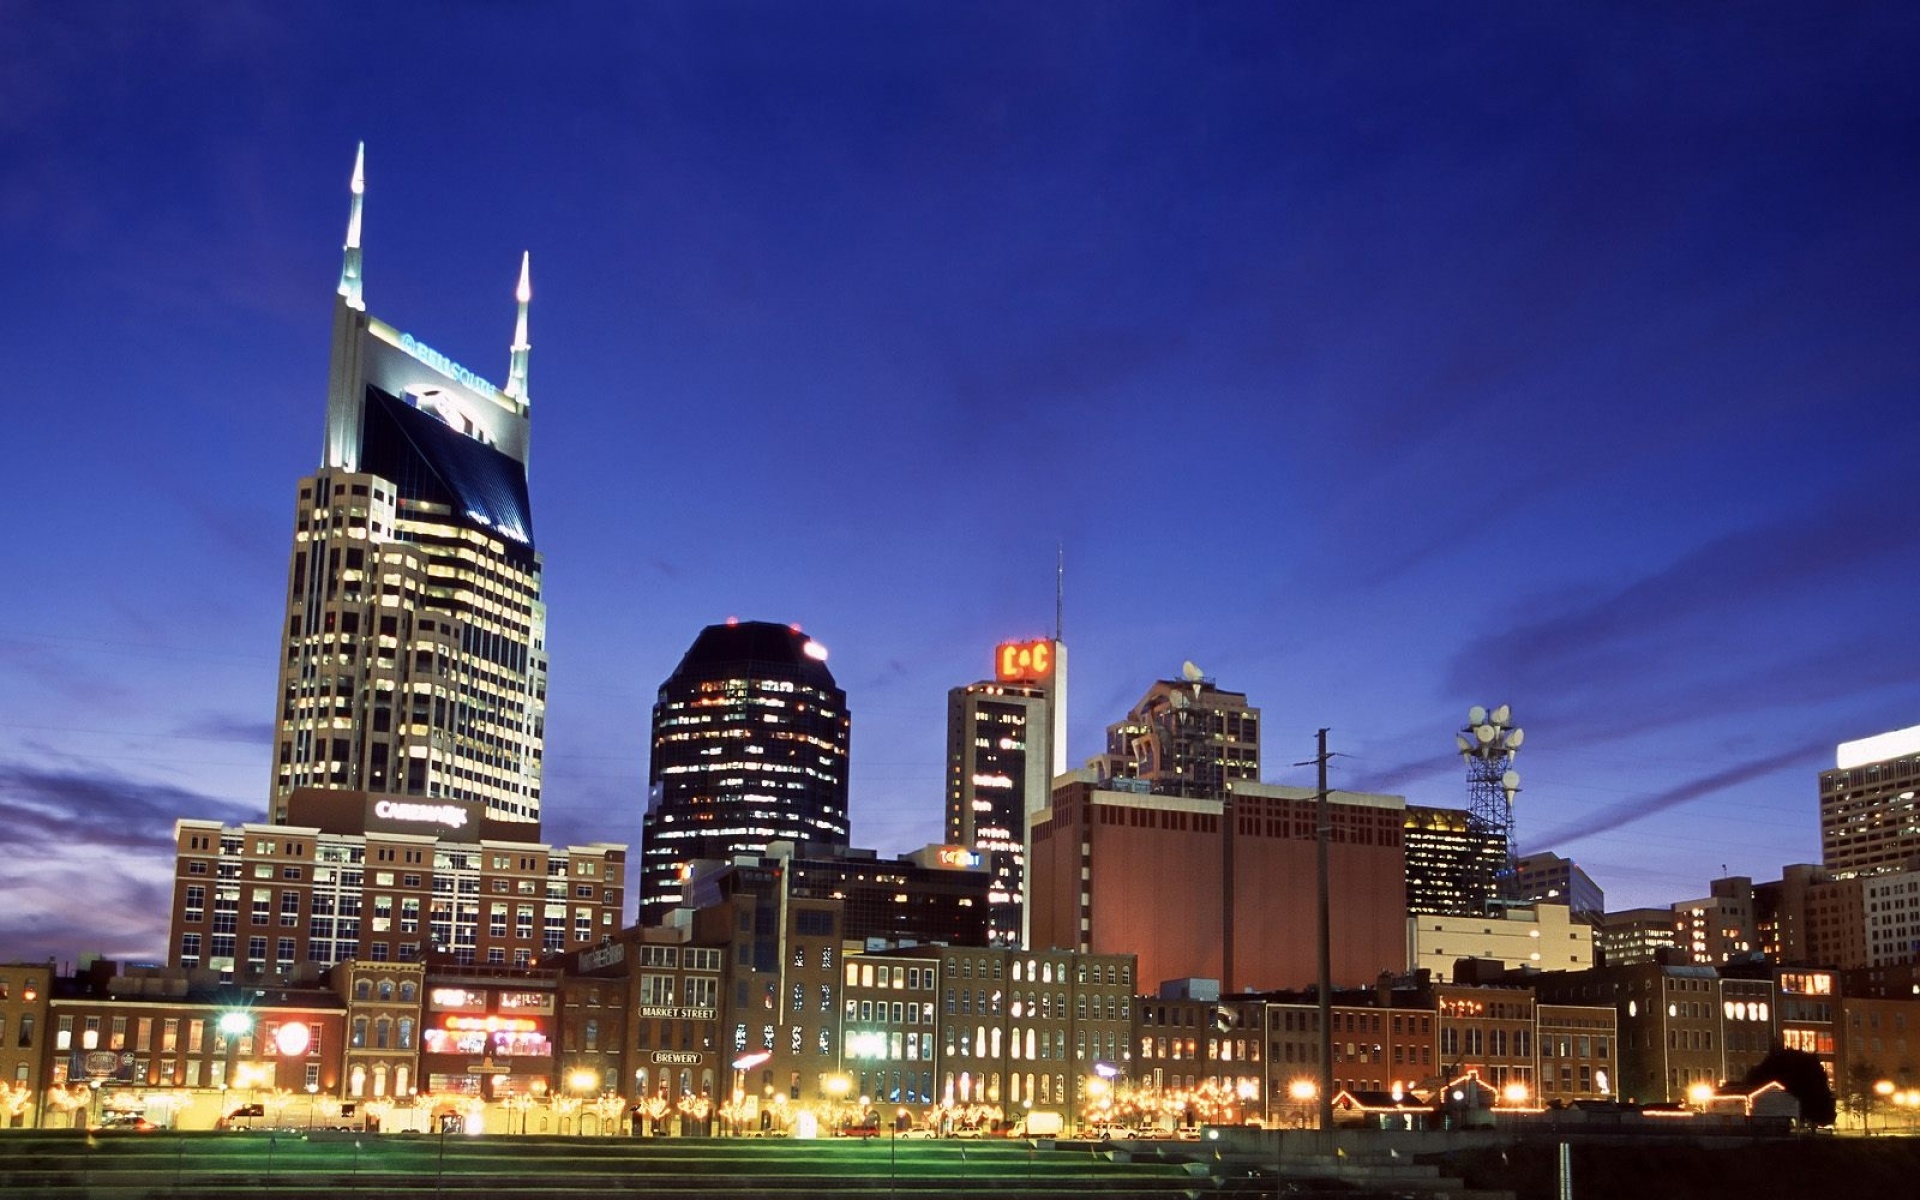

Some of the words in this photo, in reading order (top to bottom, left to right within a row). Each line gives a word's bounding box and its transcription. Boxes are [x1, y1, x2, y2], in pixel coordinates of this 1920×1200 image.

[642, 1007, 678, 1017] MARKET
[681, 1009, 714, 1018] STREET
[656, 1053, 698, 1063] BREWERY
